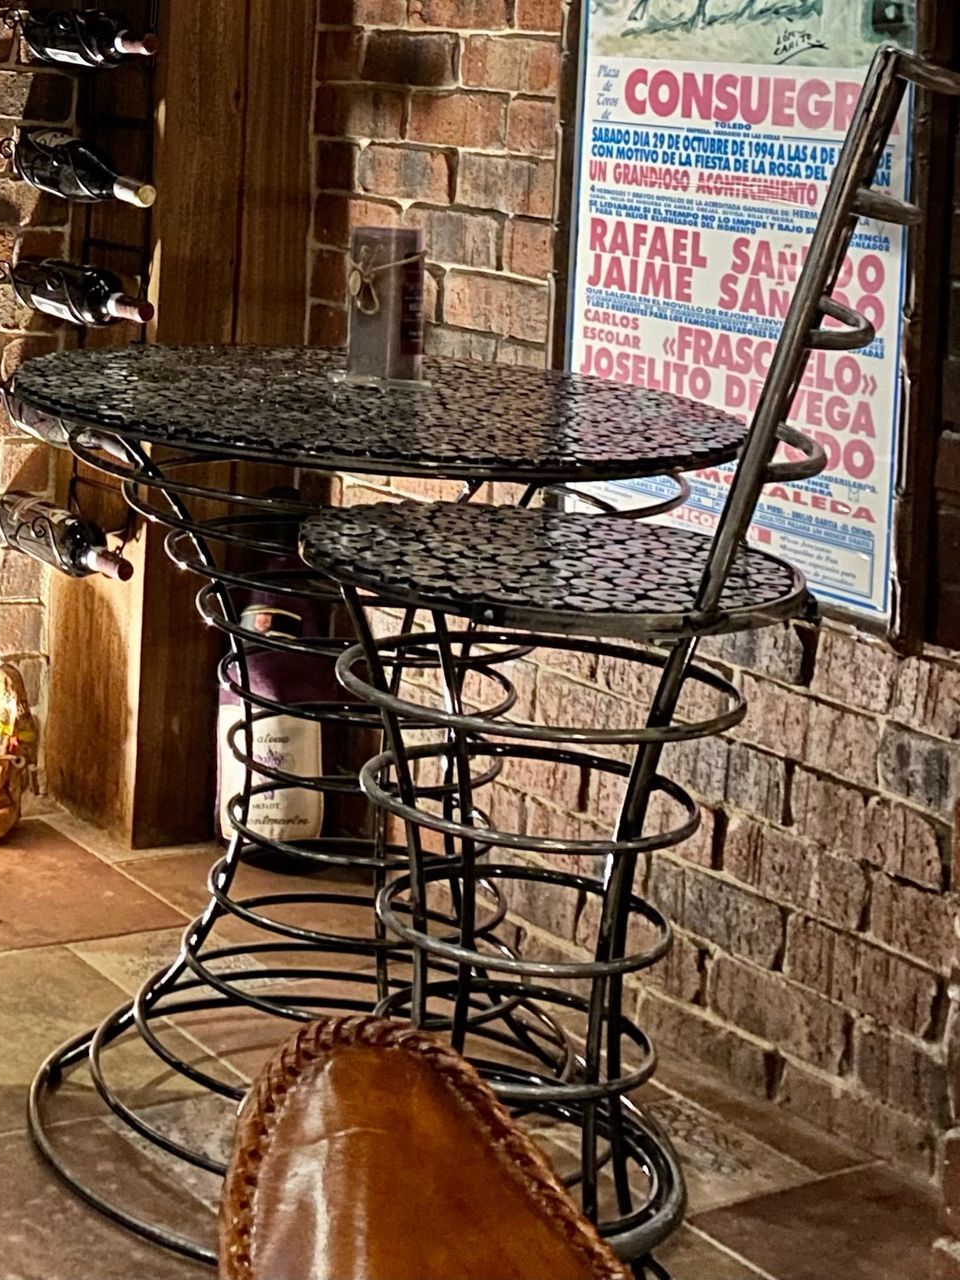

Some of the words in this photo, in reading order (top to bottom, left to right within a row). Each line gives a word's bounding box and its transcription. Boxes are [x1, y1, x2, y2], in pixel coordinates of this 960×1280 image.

[624, 68, 900, 135] CONSUEGR
[715, 122, 752, 131] TOLEDO
[591, 144, 614, 159] CON
[615, 146, 659, 164] MOTIVO
[661, 151, 676, 166] DE
[678, 152, 692, 168] LA
[694, 154, 731, 172] FIESTA
[733, 157, 749, 173] DE
[751, 159, 766, 175] LA
[768, 161, 802, 179] ROSA
[804, 164, 827, 181] DEL
[592, 126, 631, 146] SABADO
[632, 130, 650, 147] DIA
[652, 132, 665, 149] 29
[667, 133, 681, 151] DE
[682, 135, 729, 156] OCTUBRE
[731, 140, 746, 157] DE
[748, 140, 775, 161] 1994
[776, 143, 785, 161] A
[787, 144, 808, 163] LAS
[809, 145, 817, 164] 4
[820, 146, 835, 166] DE
[589, 160, 608, 183] UN
[613, 162, 690, 192] GRANDIOSO
[696, 171, 818, 207] ACONTECIMIENTO
[653, 207, 663, 216] EL
[664, 209, 699, 220] TIEMPO
[701, 214, 716, 222] NO
[718, 216, 731, 224] LO
[732, 217, 768, 229] IMPIDE
[769, 222, 776, 230] Y
[777, 223, 804, 234] BAJO
[700, 221, 715, 230] DEL
[717, 223, 757, 235] MOMENTO
[590, 217, 708, 269] RAFAEL
[587, 252, 693, 303] JAIME
[584, 308, 640, 331] CARLOS
[639, 295, 650, 304] EN
[652, 297, 661, 306] EL
[662, 299, 704, 313] NOVILLO
[718, 310, 760, 323] REJONES
[583, 325, 641, 350] ESCOLAR
[580, 344, 712, 400] JOSELITO
